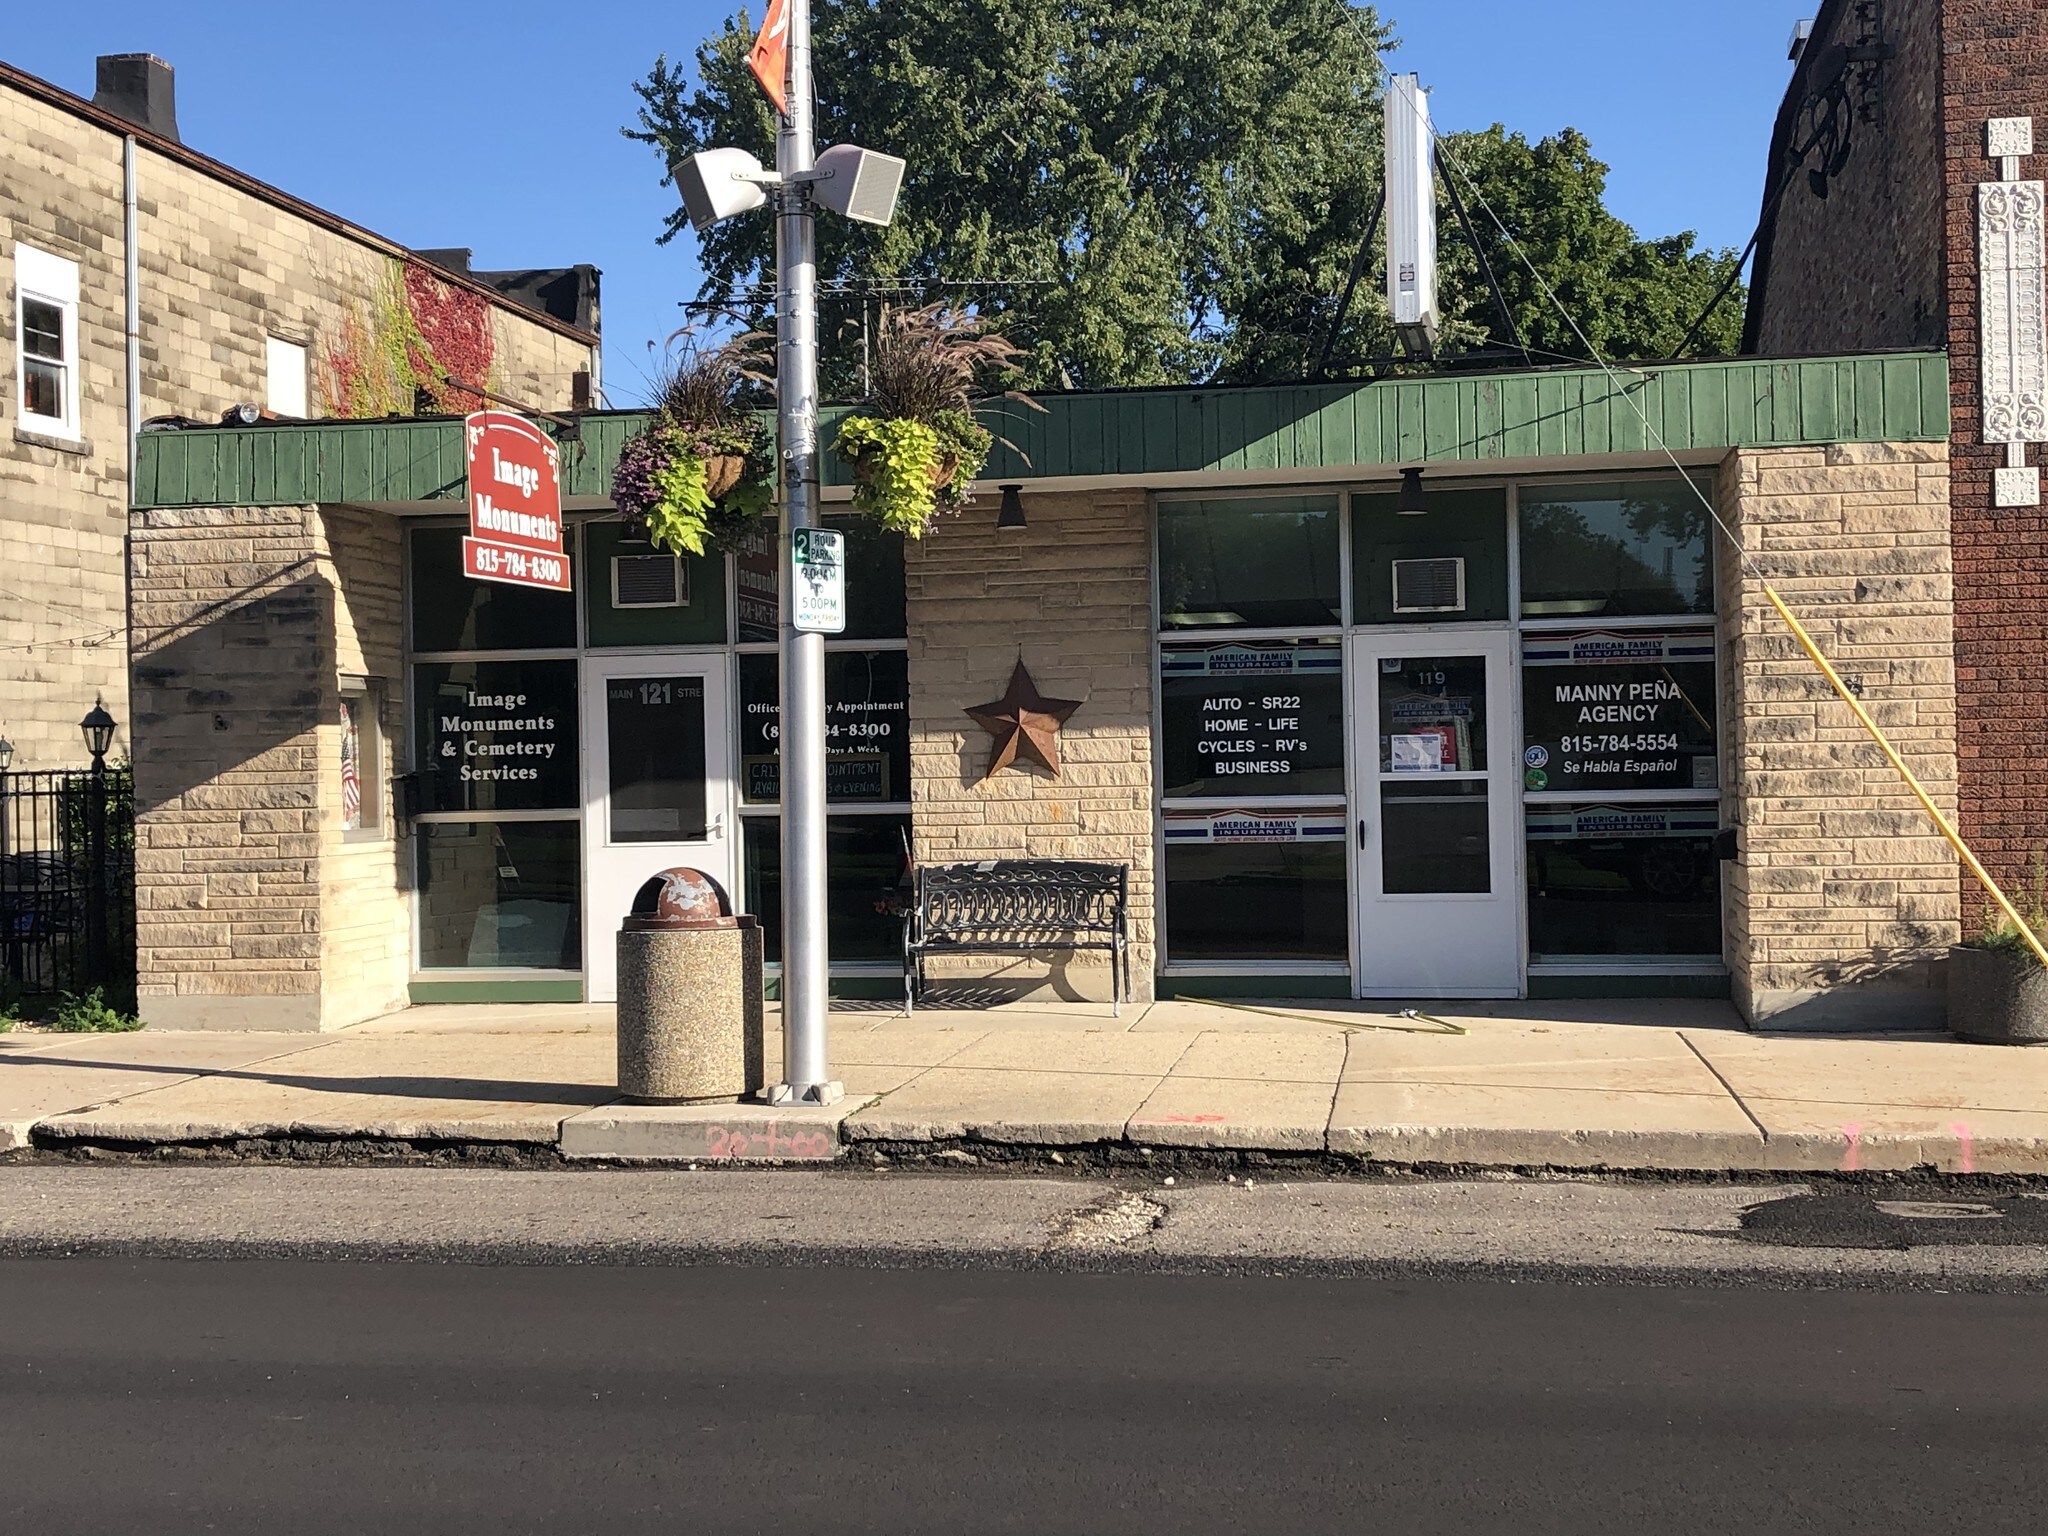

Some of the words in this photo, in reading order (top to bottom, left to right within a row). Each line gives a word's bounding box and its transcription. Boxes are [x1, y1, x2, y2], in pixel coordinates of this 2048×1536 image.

[492, 447, 539, 498] Image
[476, 493, 557, 542] Monuments
[797, 534, 809, 559] 2
[814, 534, 837, 547] HOUR
[811, 548, 840, 561] PARKING
[476, 546, 561, 582] 815-784-8300
[802, 597, 837, 610] 500PM
[1574, 642, 1624, 650] AMERICAN
[1628, 641, 1663, 649] FAMILY
[1210, 653, 1257, 661] AMERICAN
[1260, 652, 1293, 660] FAMILY
[1418, 672, 1446, 685] 119
[609, 689, 634, 699] MAIN
[639, 682, 671, 705] 121
[677, 687, 704, 698] STRE
[1556, 684, 1624, 702] MANNY
[1629, 680, 1682, 700] PEÑA
[468, 692, 526, 710] Image
[747, 703, 780, 713] Office
[836, 701, 904, 713] Appointment
[1202, 698, 1242, 711] AUTO
[1262, 697, 1301, 709] SR22
[1578, 705, 1659, 723] AGENCY
[441, 716, 555, 733] Monuments
[1205, 719, 1248, 732] HOME
[1268, 718, 1299, 730] LIFE
[441, 741, 456, 757] &
[464, 740, 555, 758] Cemetery
[857, 745, 880, 753] Week
[1198, 740, 1255, 753] CYCLES
[1276, 739, 1307, 751] RV's
[1561, 733, 1678, 753] 815-784-5554
[460, 765, 538, 781] Services
[1215, 761, 1290, 774] BUSINESS
[1563, 761, 1580, 773] Se
[1583, 759, 1620, 773] Habla
[1624, 759, 1677, 775] Español
[1213, 820, 1260, 829] AMERICAN
[1264, 820, 1297, 828] FAMILY
[1577, 815, 1628, 823] AMERICAN
[1632, 814, 1666, 822] FAMILY
